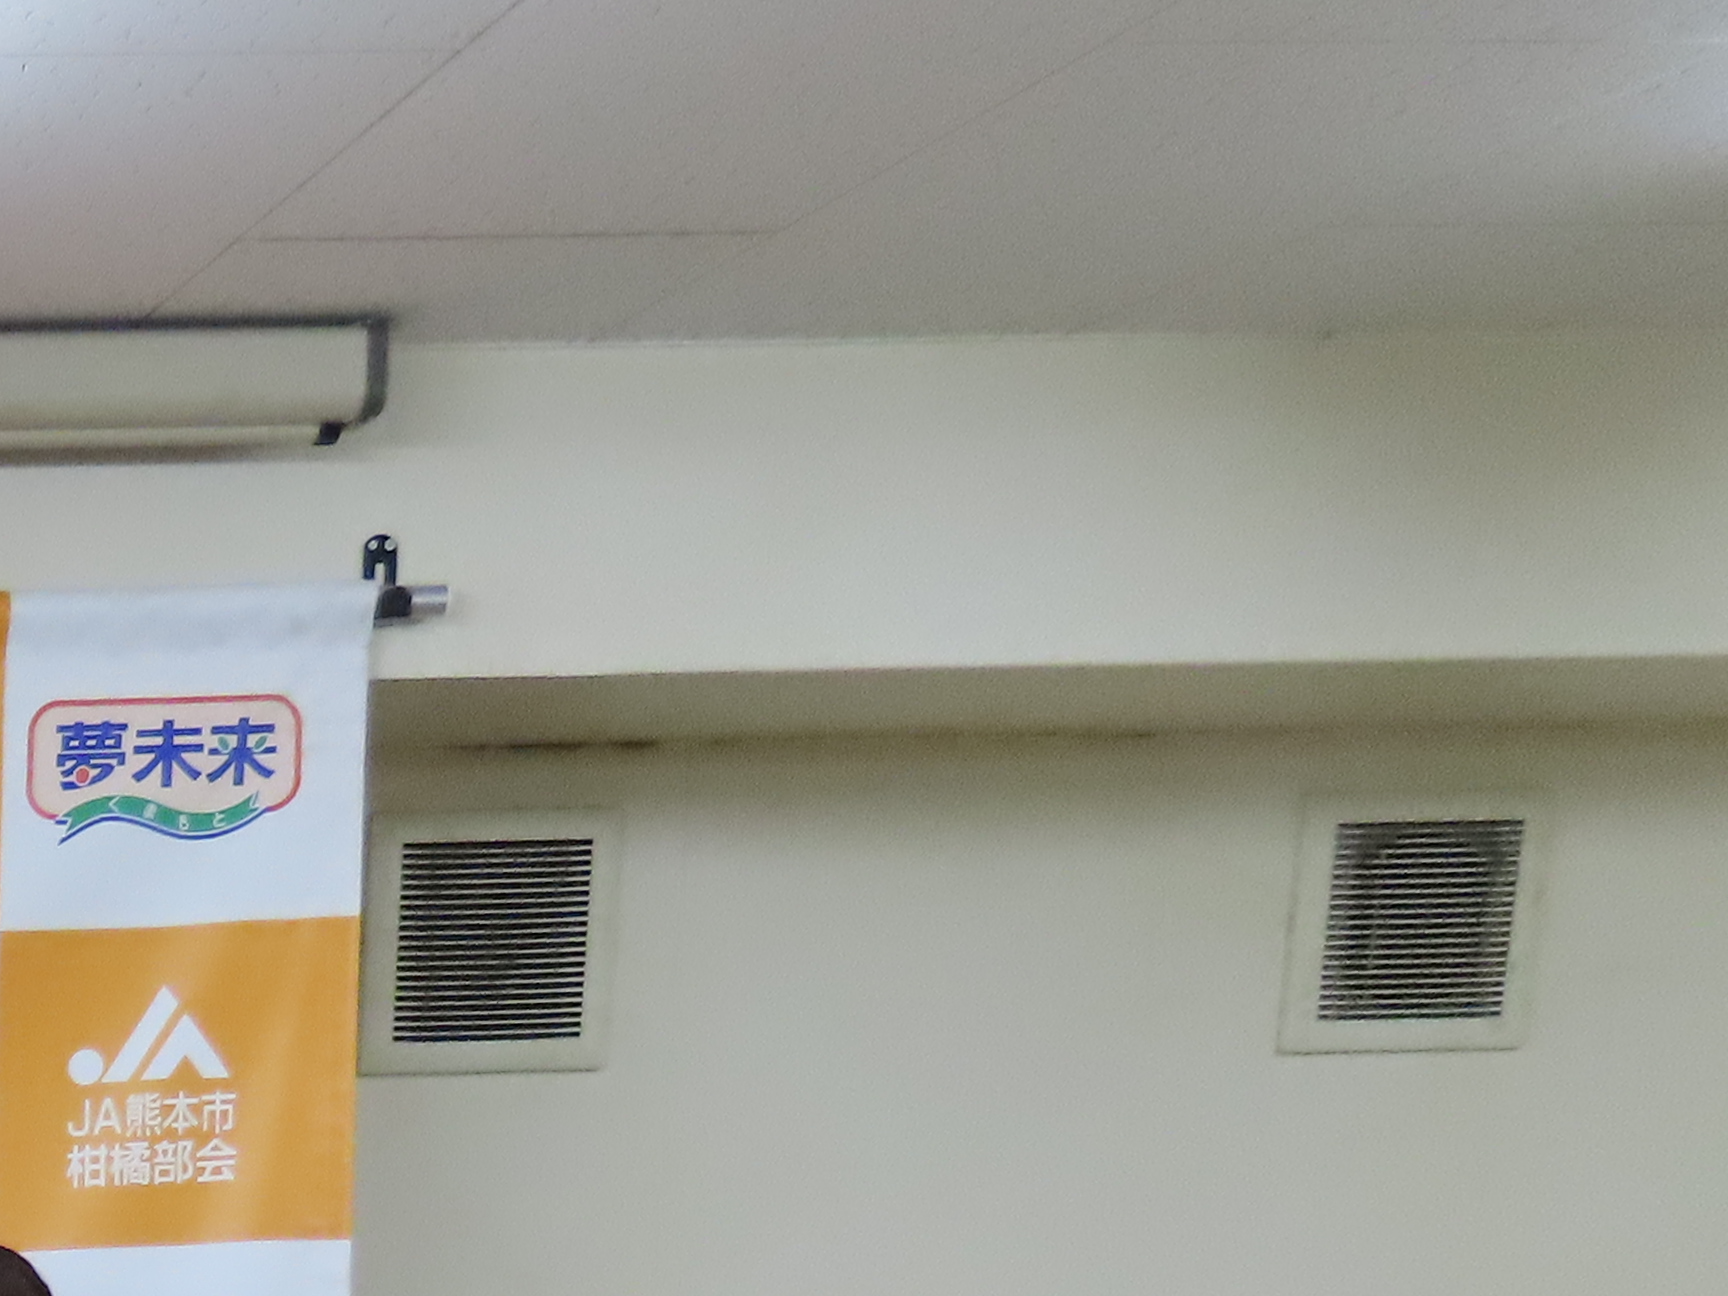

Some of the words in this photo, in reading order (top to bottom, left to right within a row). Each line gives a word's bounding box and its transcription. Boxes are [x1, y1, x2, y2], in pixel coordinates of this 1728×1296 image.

[58, 718, 277, 790] 夢未来
[67, 1088, 239, 1138] JA熊本市
[65, 1138, 243, 1188] 柑橘部会
